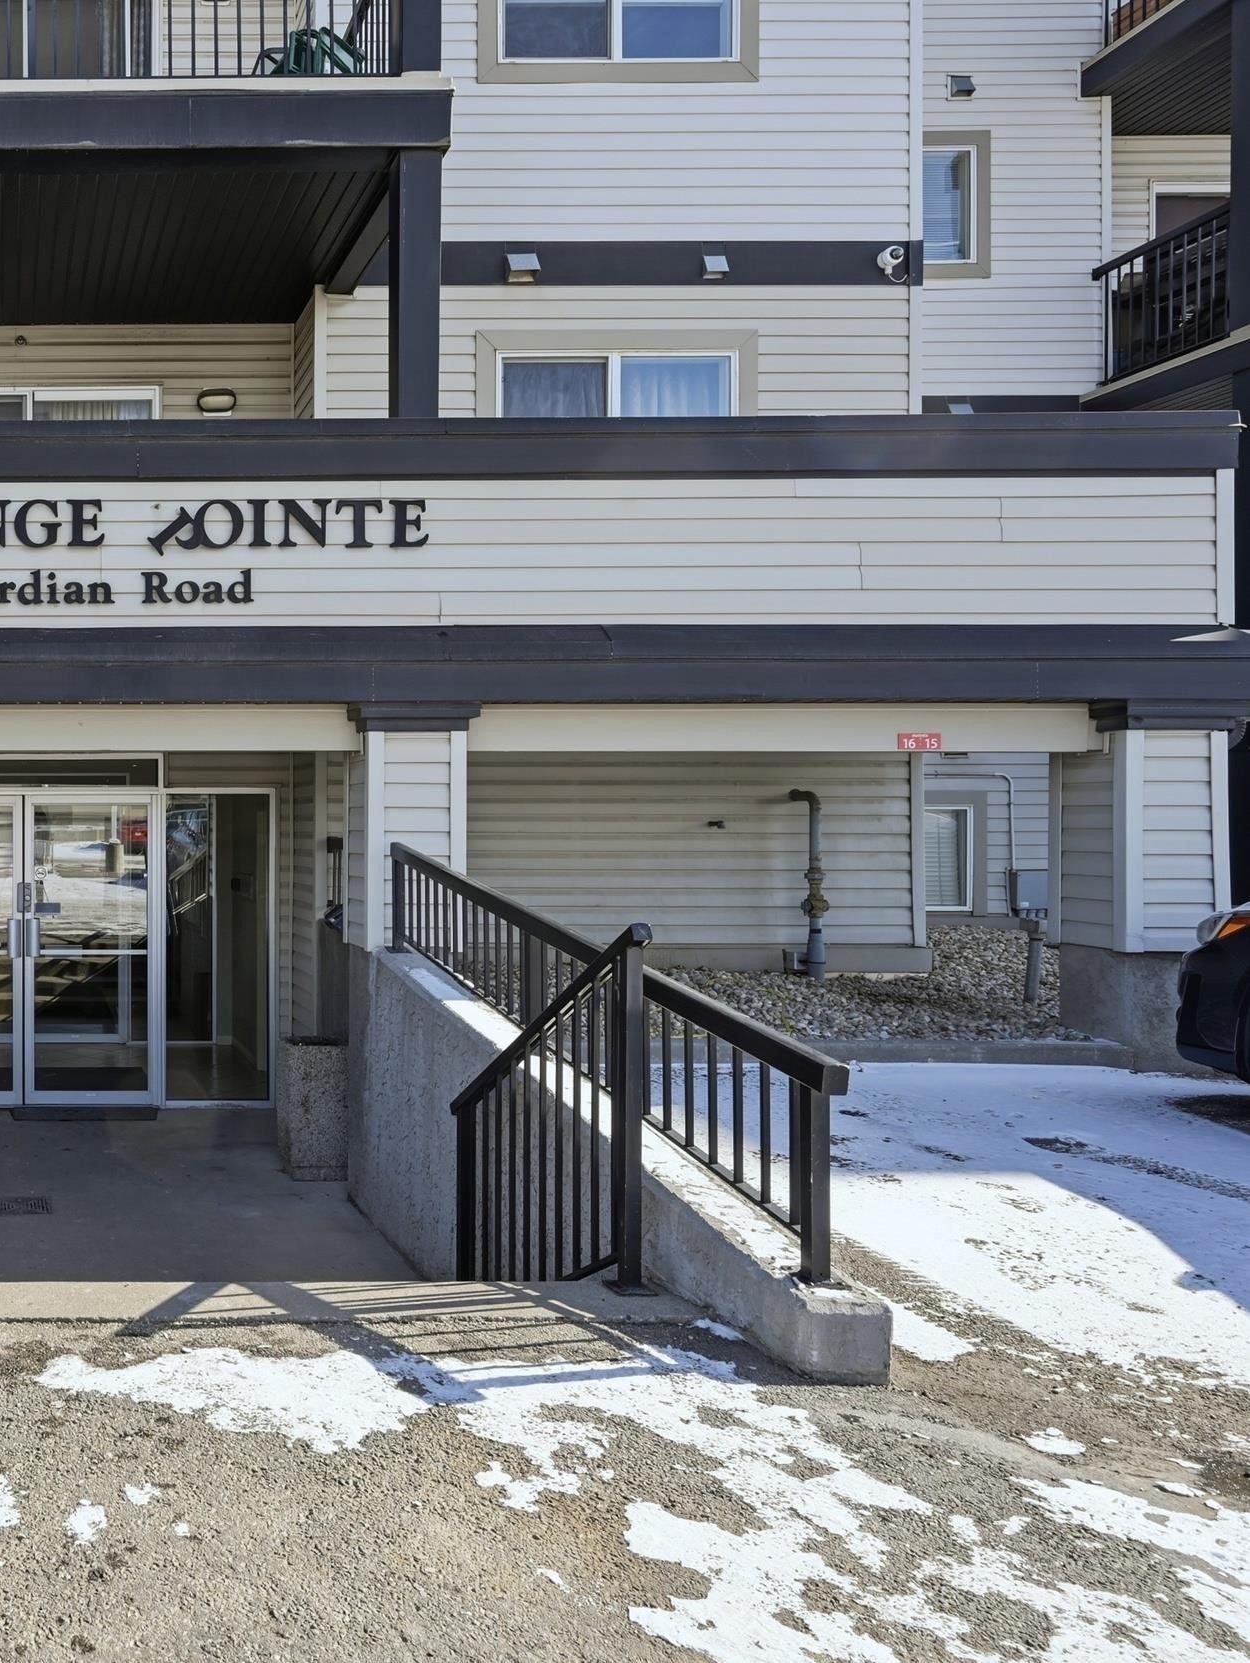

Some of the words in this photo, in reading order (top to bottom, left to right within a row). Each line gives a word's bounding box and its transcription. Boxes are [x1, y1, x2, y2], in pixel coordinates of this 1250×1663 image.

[141, 568, 254, 604] Road
[902, 738, 916, 749] 16
[925, 738, 938, 749] 15
